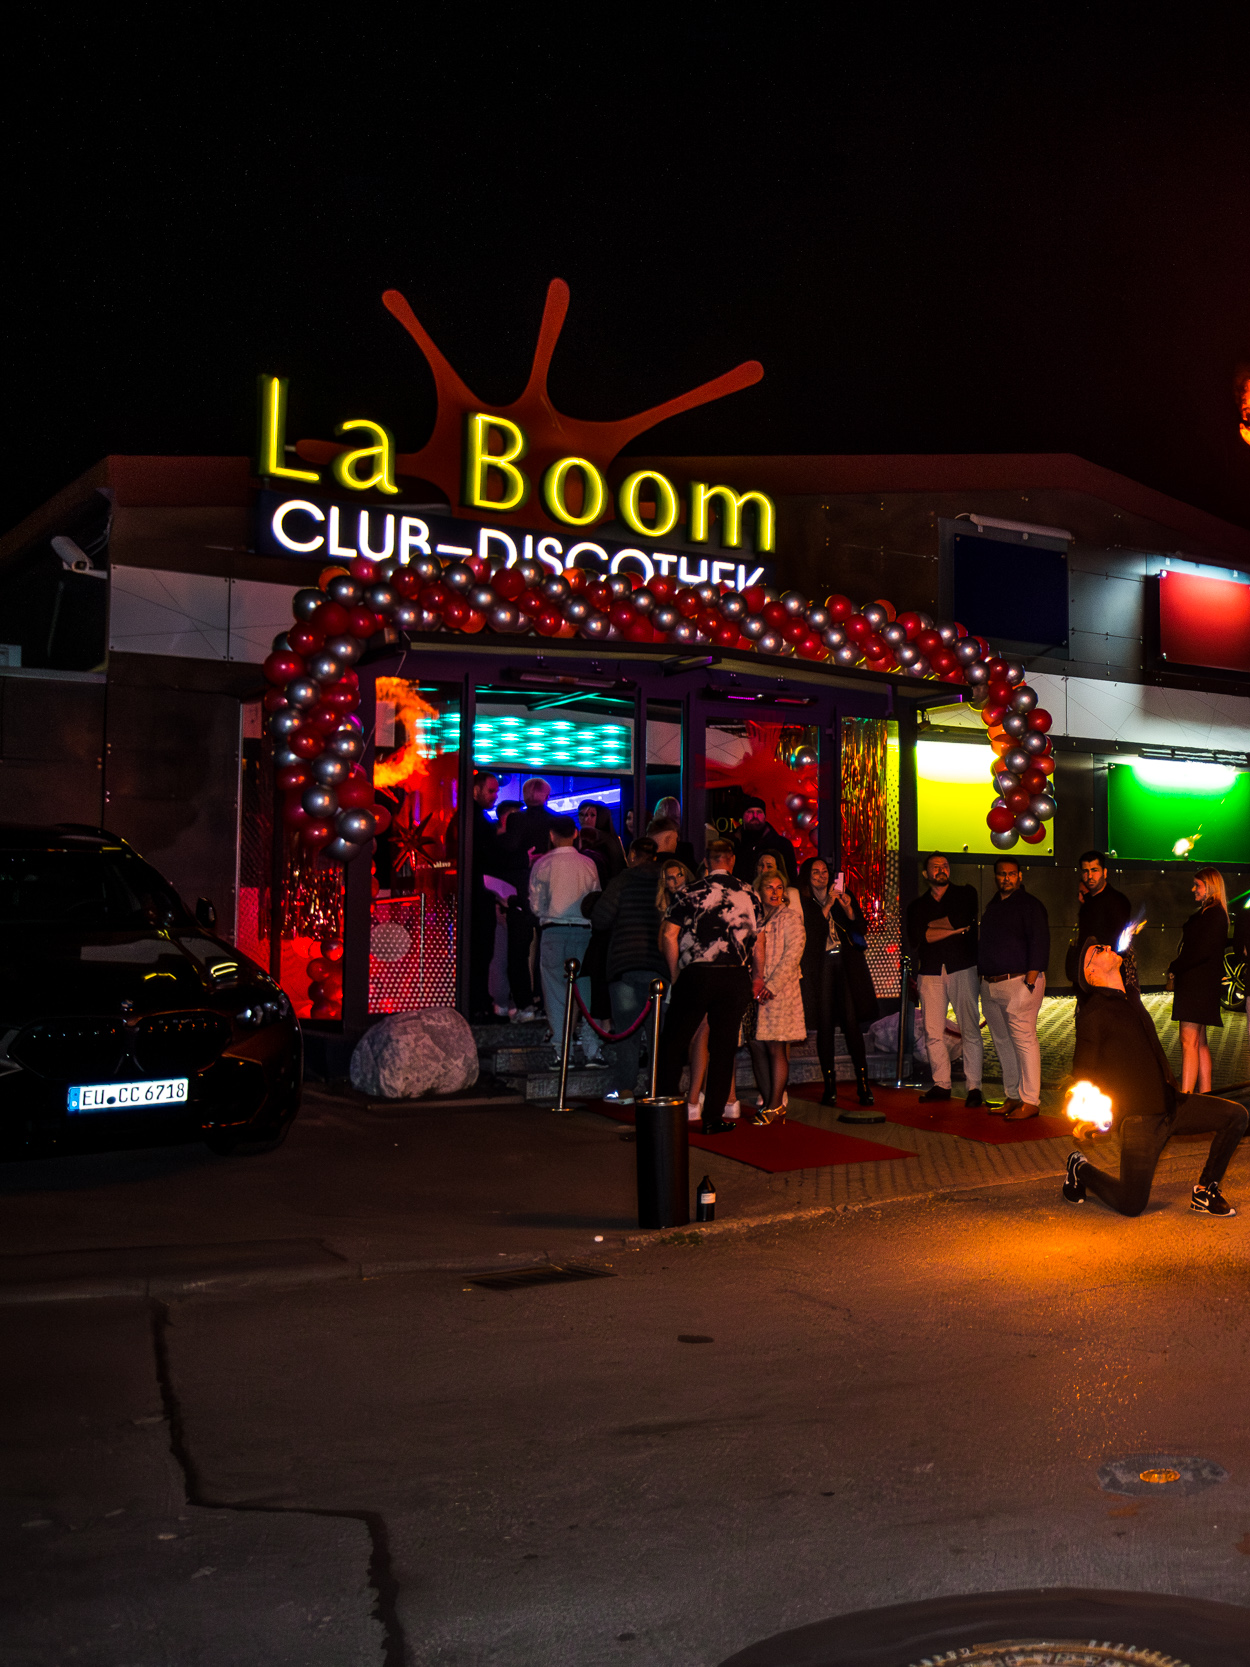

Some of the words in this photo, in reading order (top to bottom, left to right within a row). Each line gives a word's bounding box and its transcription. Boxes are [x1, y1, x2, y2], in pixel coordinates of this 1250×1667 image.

[259, 374, 398, 496] La
[463, 411, 776, 553] Boom
[82, 1089, 105, 1106] EU
[118, 1086, 140, 1103] CC
[144, 1083, 185, 1101] 6718
